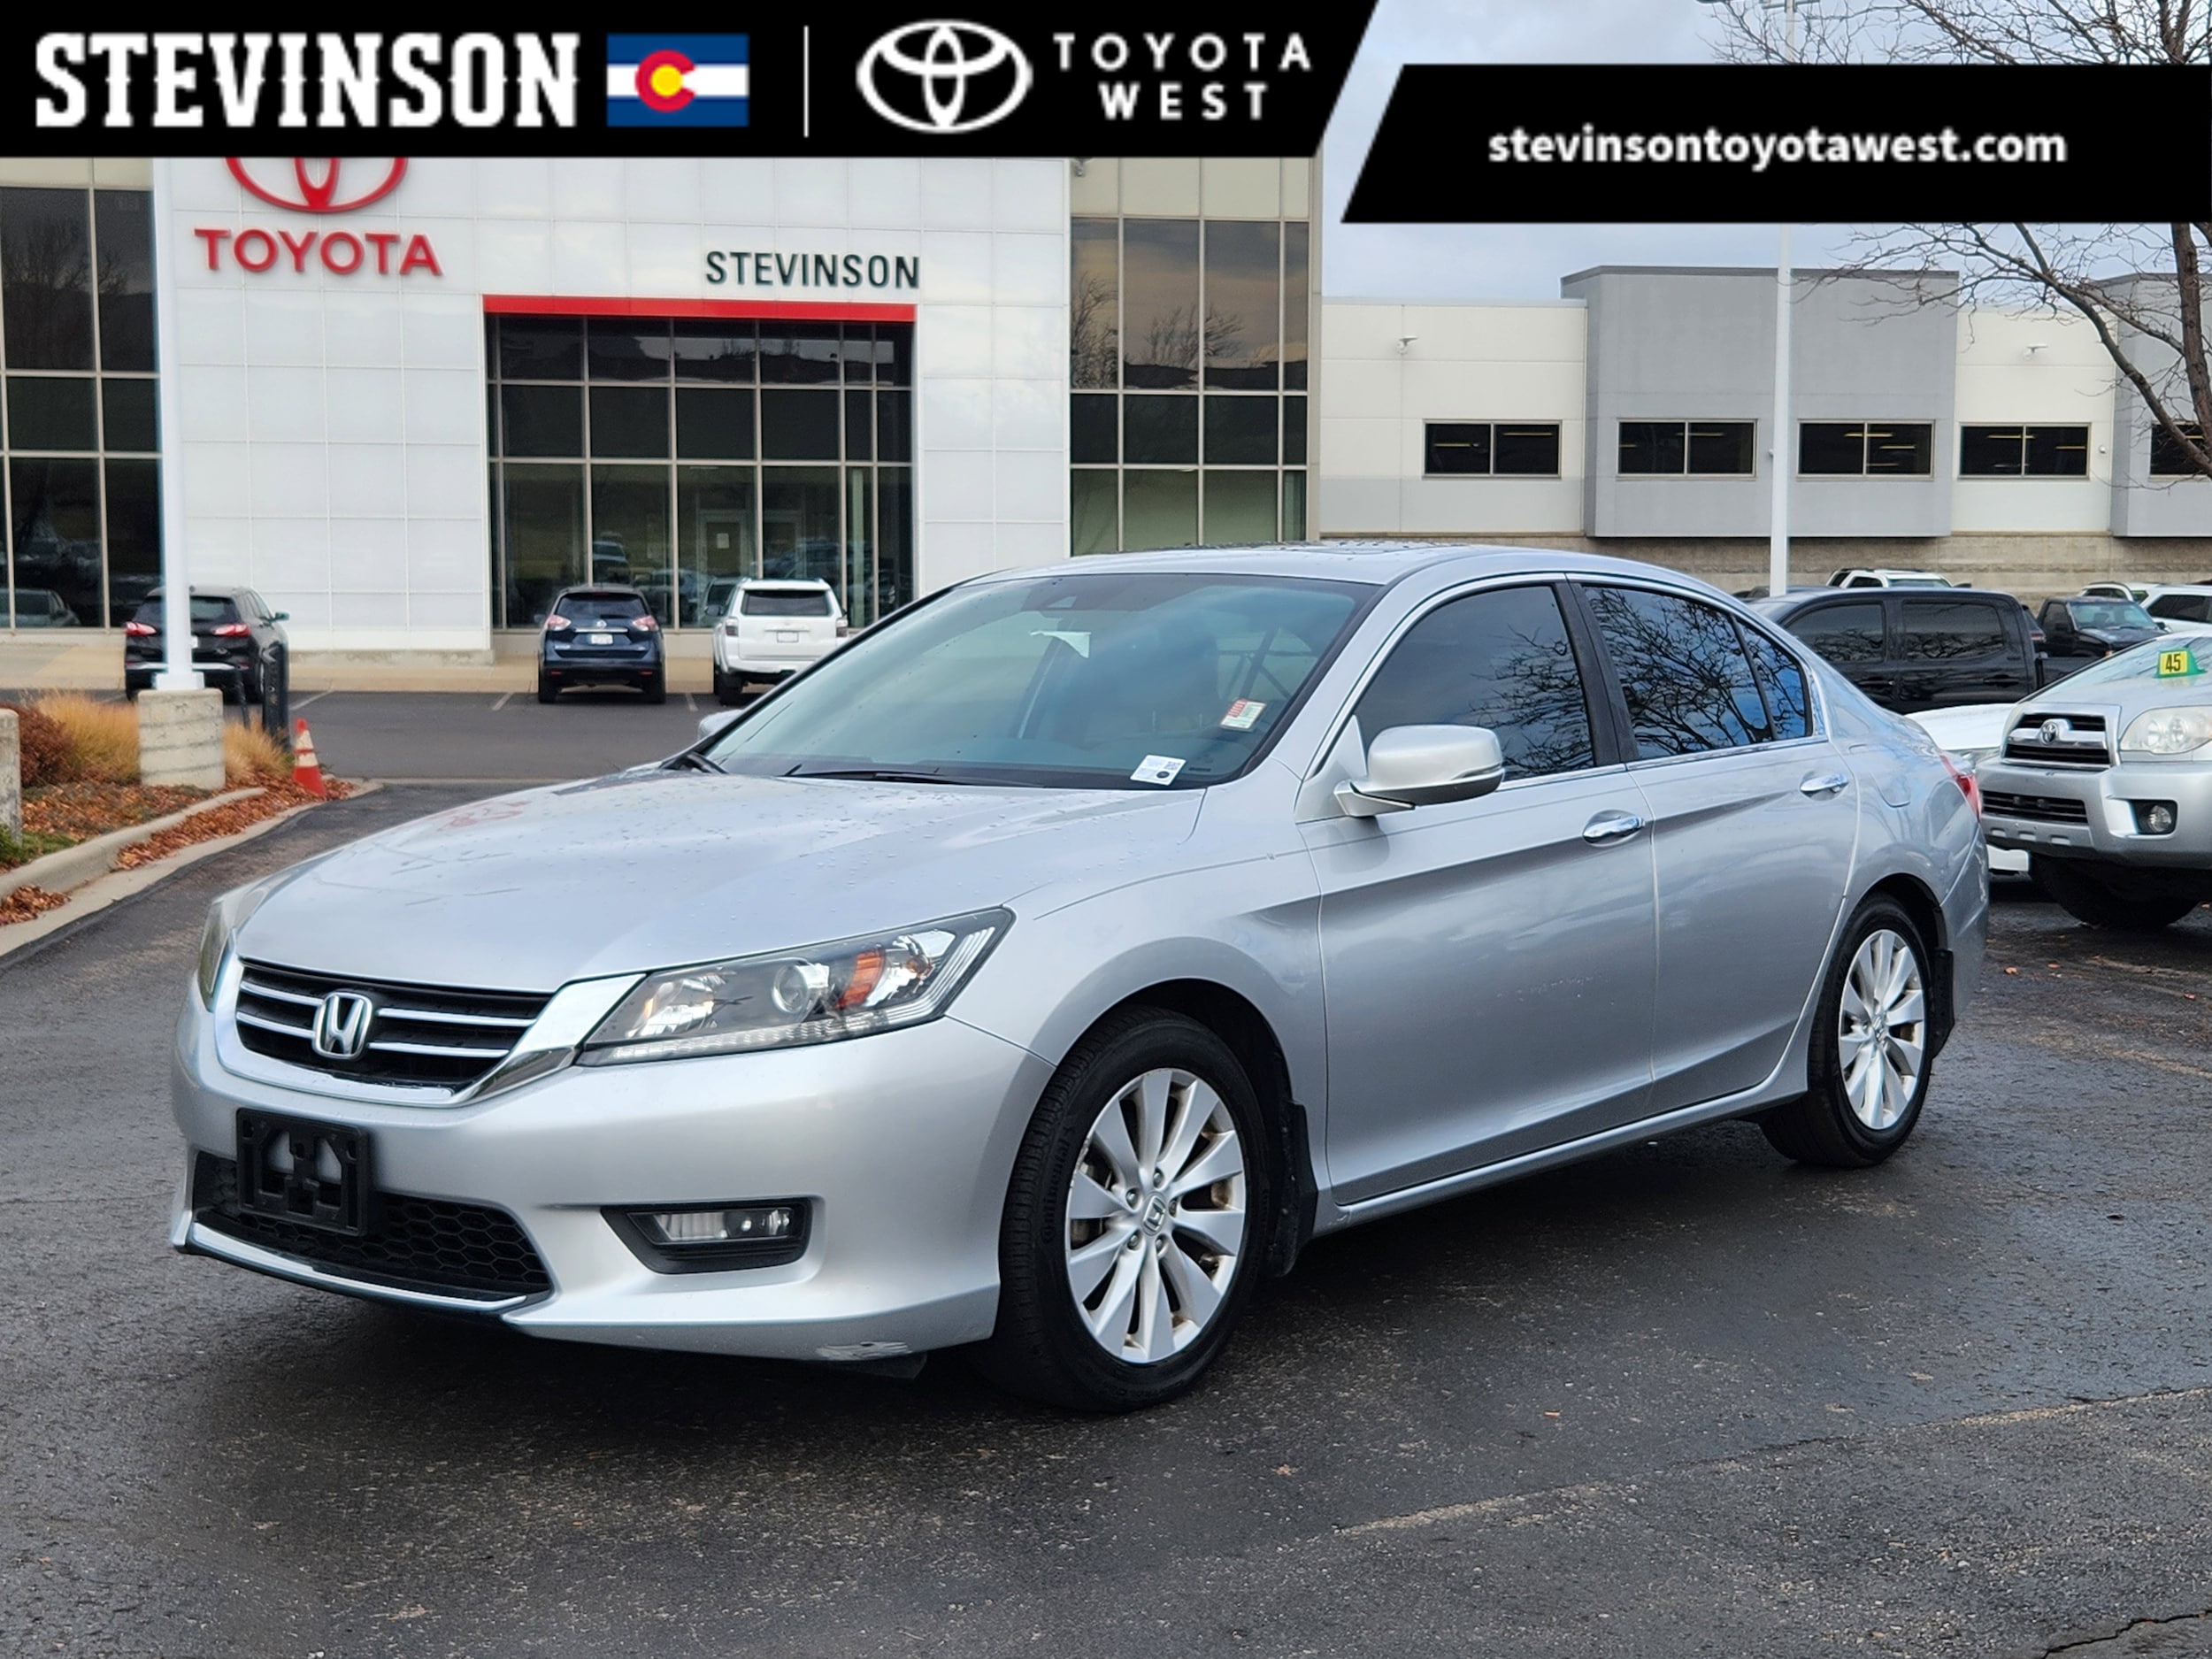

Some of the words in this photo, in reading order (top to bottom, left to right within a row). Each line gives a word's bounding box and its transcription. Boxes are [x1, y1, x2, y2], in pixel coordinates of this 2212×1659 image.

[195, 228, 442, 276] TOYOTA
[706, 250, 919, 288] STEVINSON
[2165, 653, 2181, 672] 45
